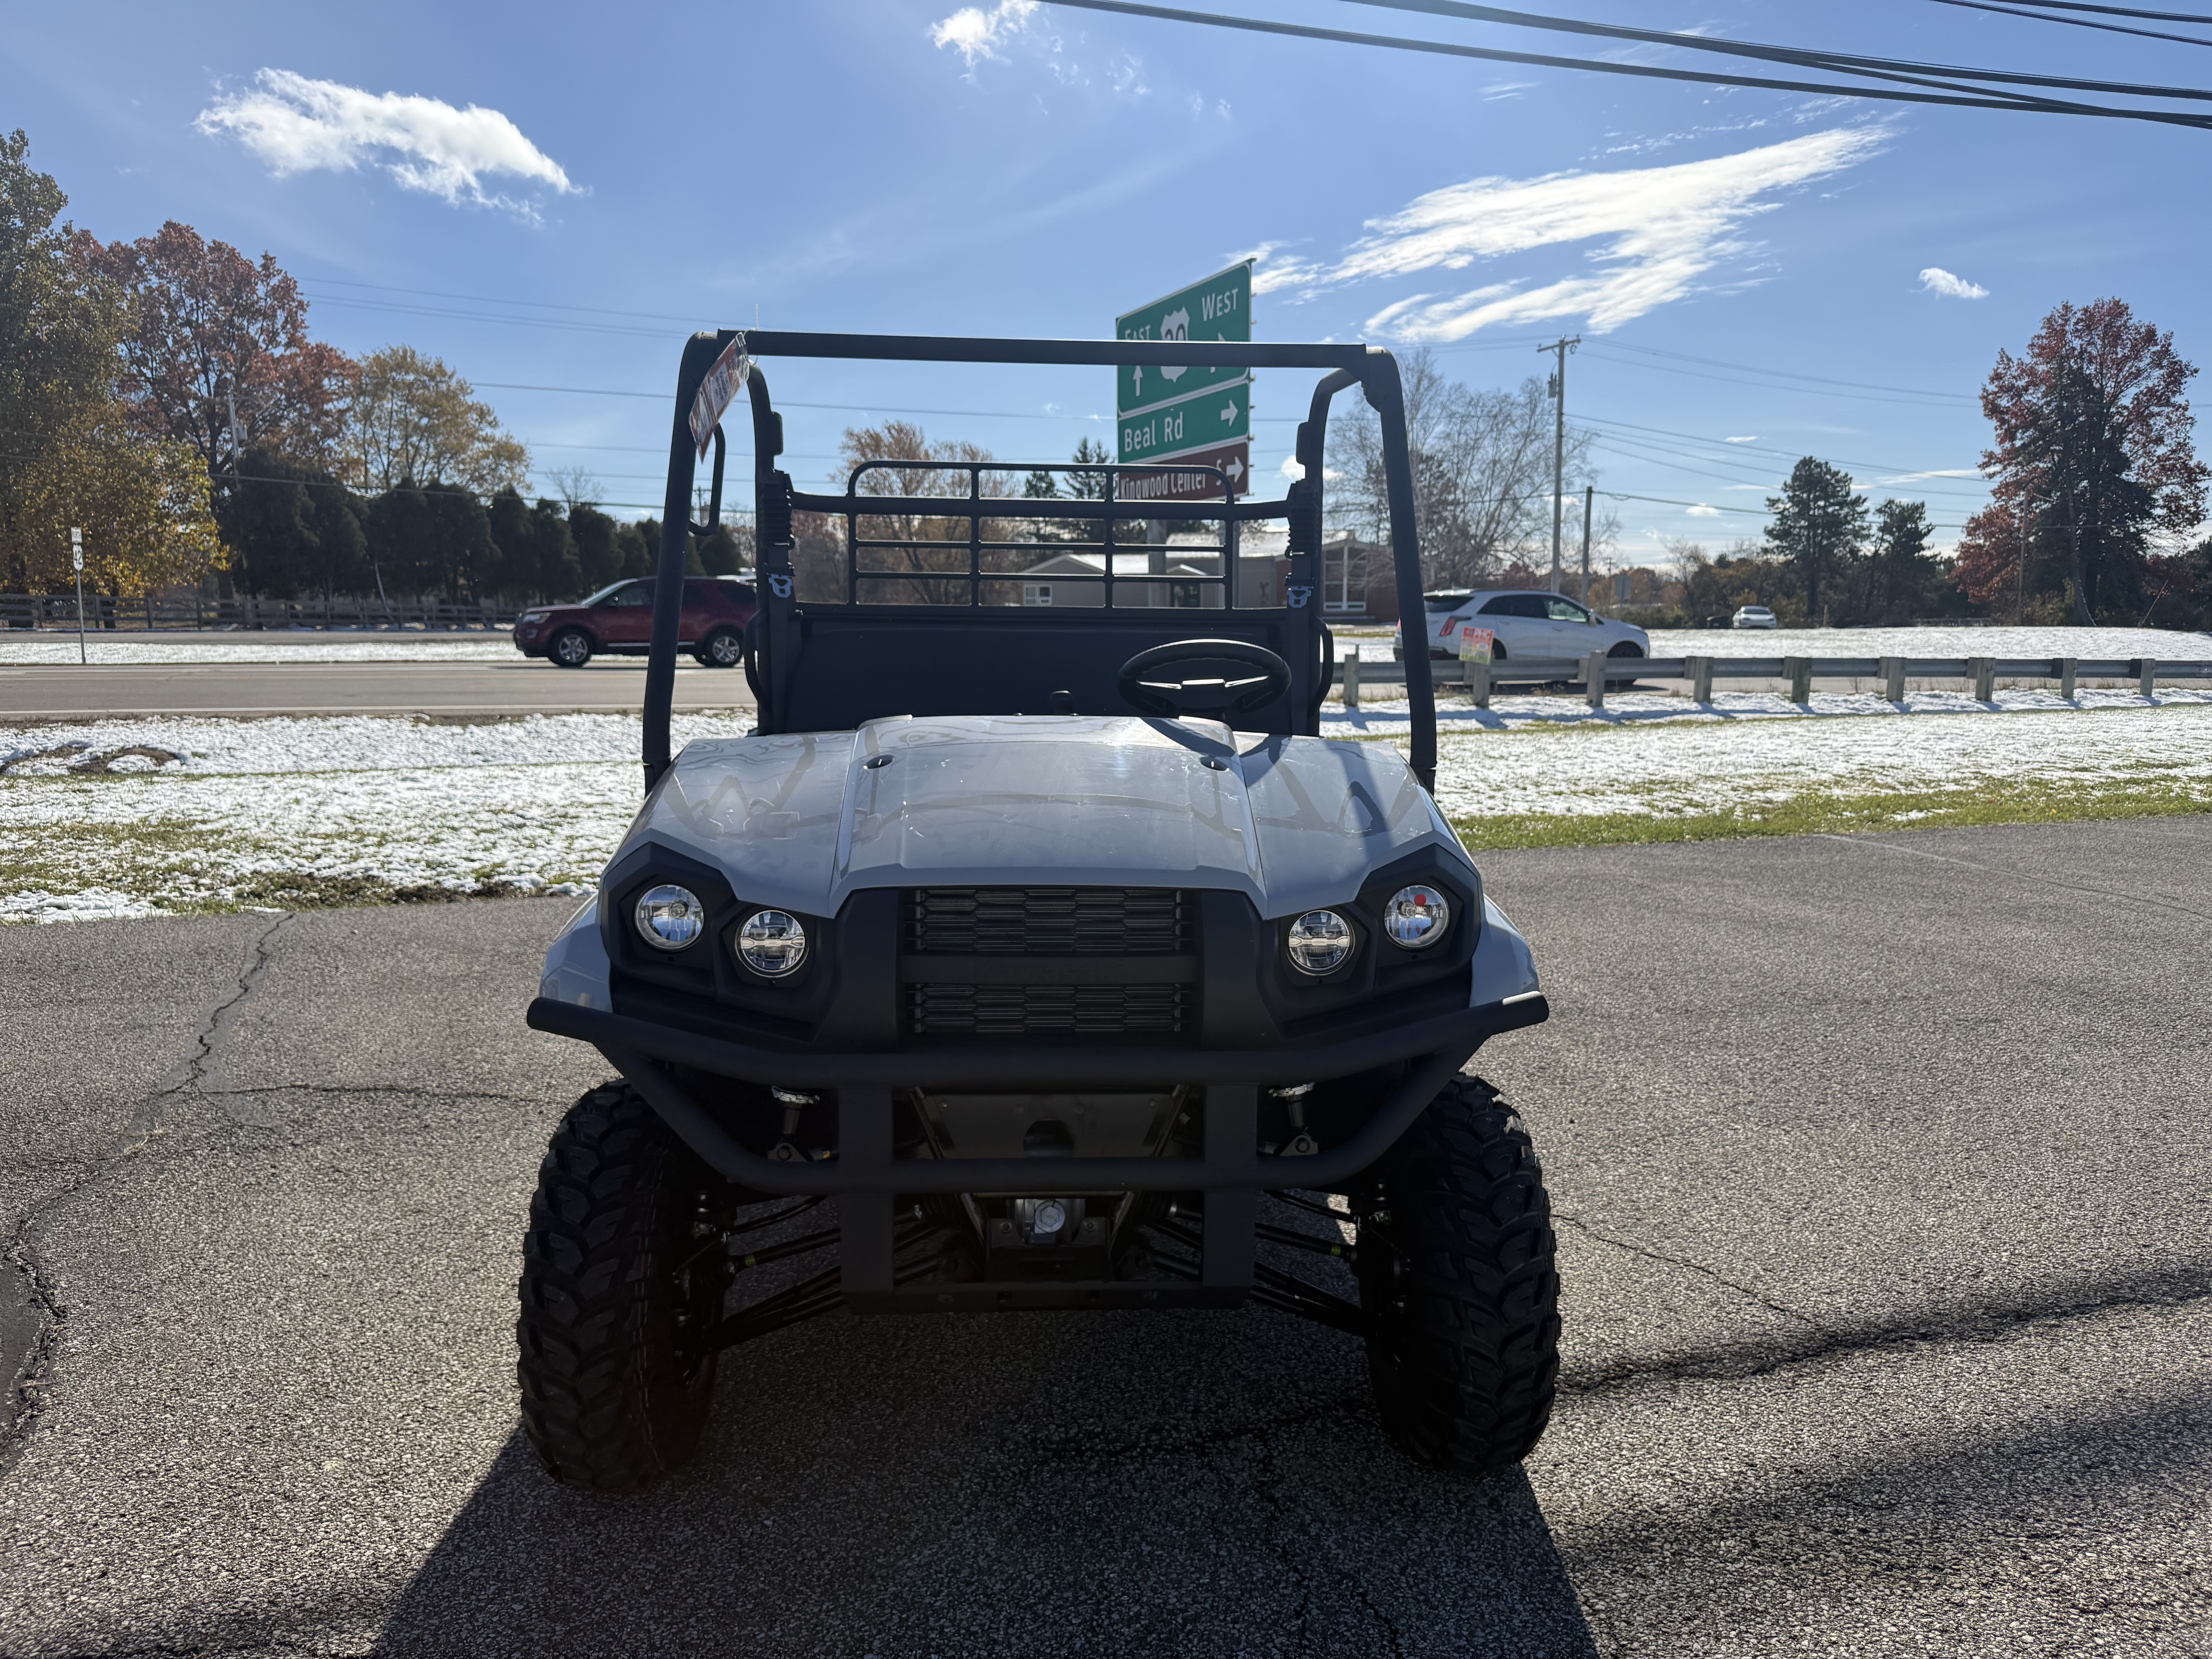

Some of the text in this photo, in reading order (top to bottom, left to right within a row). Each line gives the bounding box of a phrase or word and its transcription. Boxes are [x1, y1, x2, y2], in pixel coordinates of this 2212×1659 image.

[1202, 288, 1238, 321] WEST
[1125, 411, 1183, 452] Beal Rd
[1121, 473, 1168, 500] Kingwood
[74, 550, 82, 565] 42
